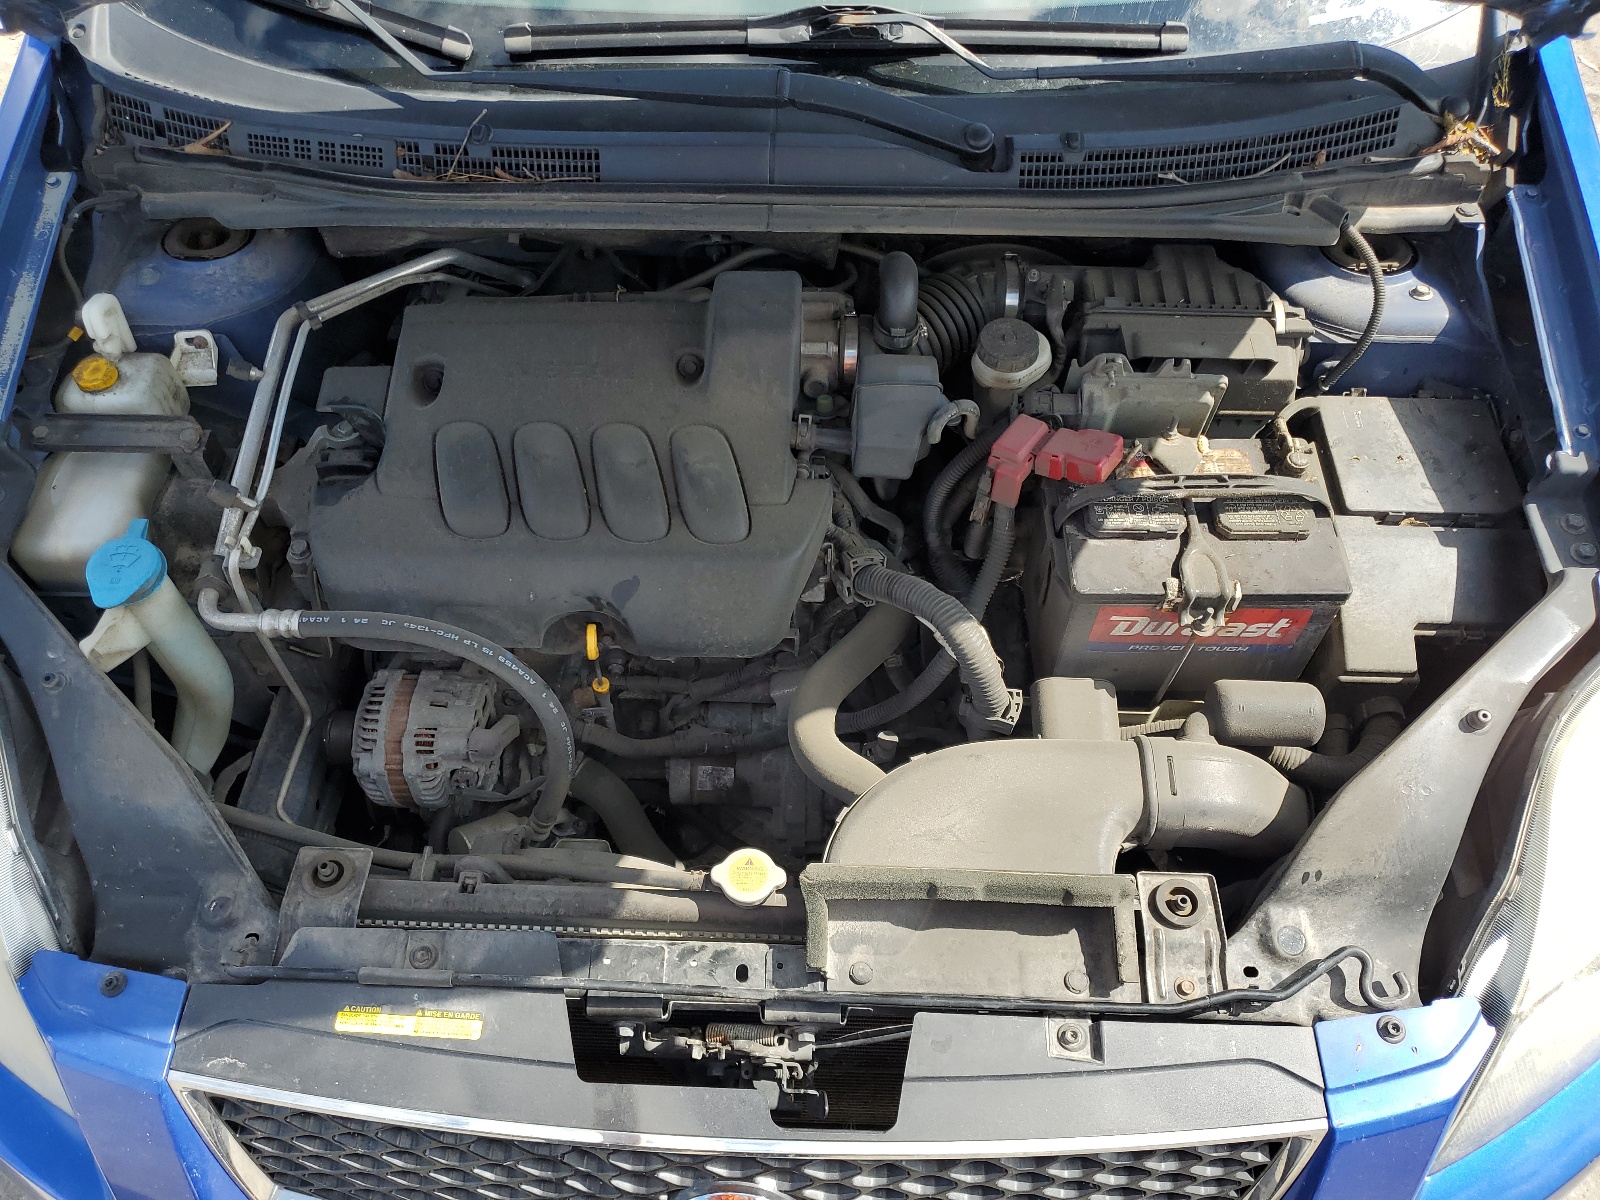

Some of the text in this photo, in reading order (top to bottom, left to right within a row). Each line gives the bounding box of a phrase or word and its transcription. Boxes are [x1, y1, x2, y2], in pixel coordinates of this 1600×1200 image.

[463, 639, 479, 649] LP
[350, 1005, 382, 1013] CAUTION
[424, 1010, 481, 1020] MISE EN GARDE
